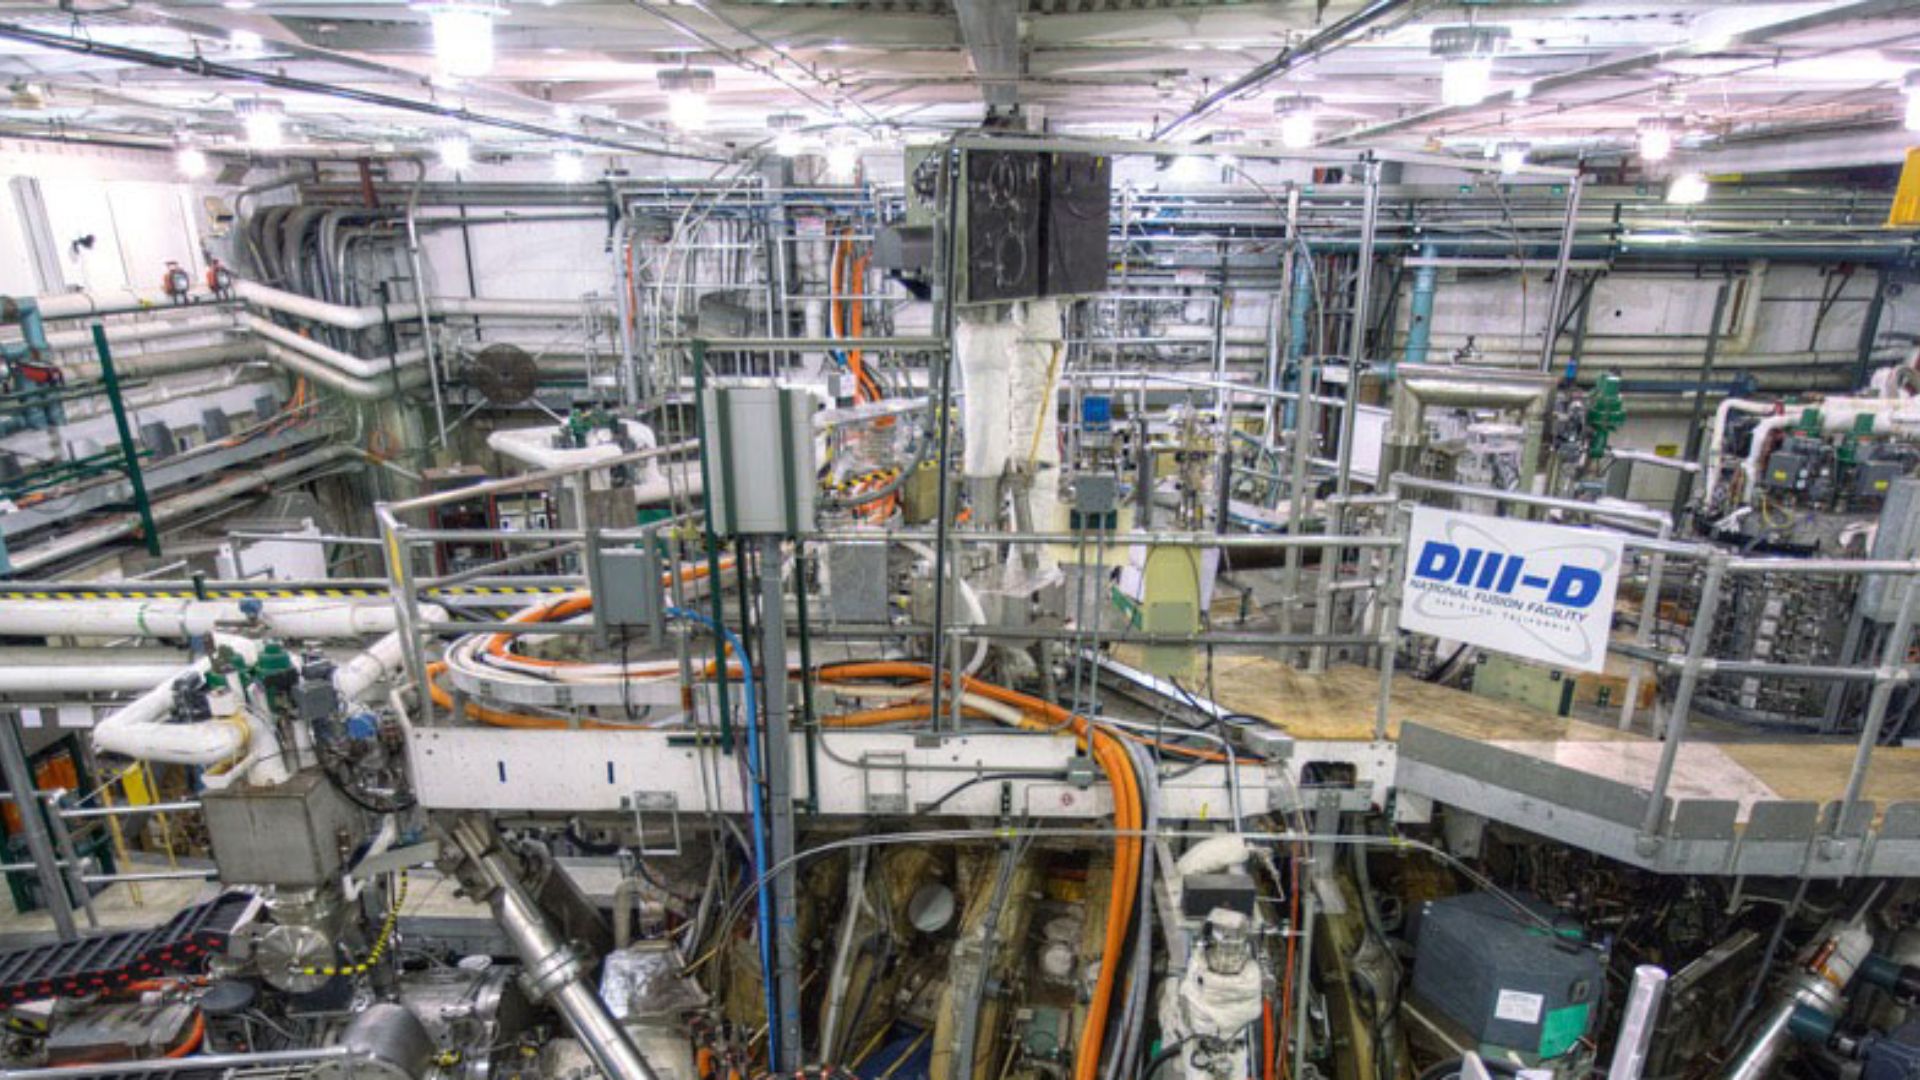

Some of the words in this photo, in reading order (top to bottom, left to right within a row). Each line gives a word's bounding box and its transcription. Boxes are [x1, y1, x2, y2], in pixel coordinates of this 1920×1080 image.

[1410, 579, 1469, 599] NATIONAL
[1475, 593, 1522, 610] FUSION
[1528, 602, 1588, 622] FACILITY
[1415, 541, 1602, 608] DIII-D
